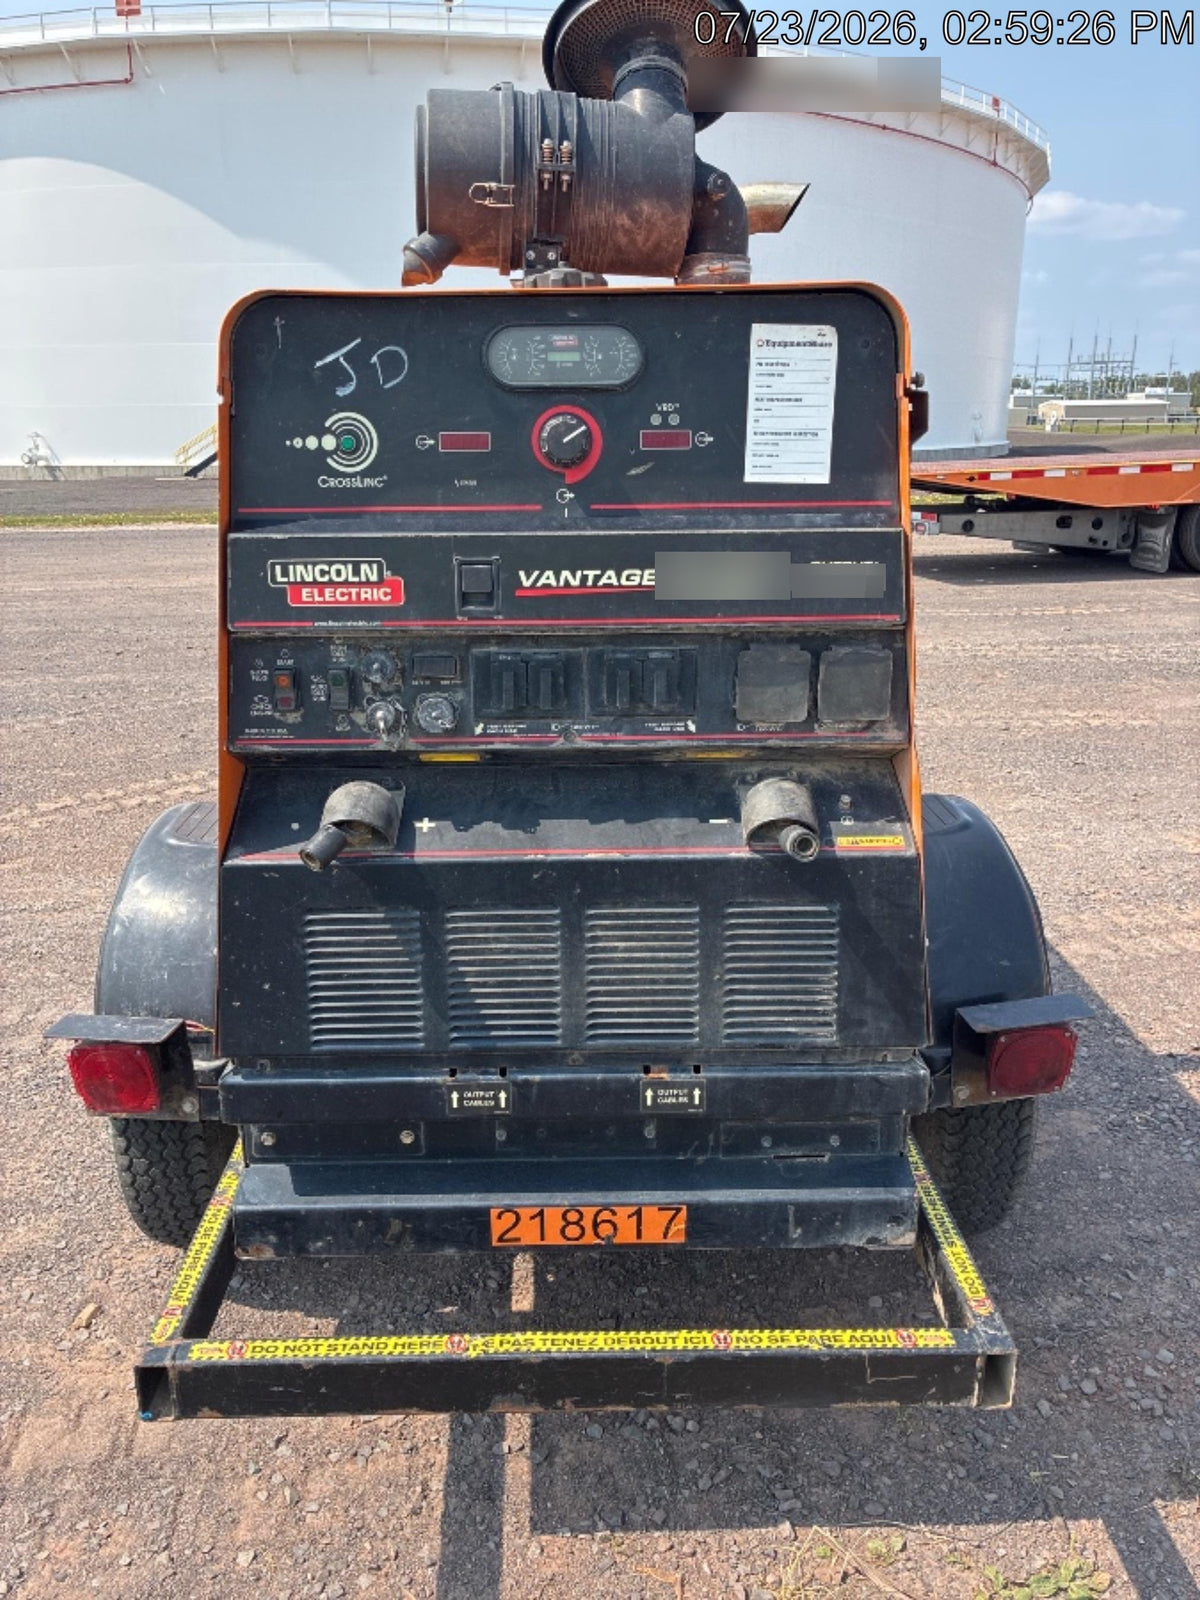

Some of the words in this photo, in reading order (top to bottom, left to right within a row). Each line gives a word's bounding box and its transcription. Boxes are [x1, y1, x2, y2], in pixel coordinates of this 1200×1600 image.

[275, 563, 378, 583] LINCOLN
[518, 569, 655, 587] VANTAGE
[301, 588, 392, 602] ELECTRIC
[495, 1207, 683, 1244] 218617
[251, 1345, 277, 1354] DO
[282, 1343, 323, 1354] NOT
[326, 1341, 389, 1352] STAND
[393, 1340, 443, 1351] HERE
[499, 1337, 536, 1347] PAS
[538, 1336, 600, 1347] TENEZ
[683, 1336, 707, 1345] ICI
[735, 1335, 762, 1344] NO
[767, 1334, 792, 1344] SE
[795, 1334, 844, 1344] PARE
[848, 1333, 892, 1343] AQUI
